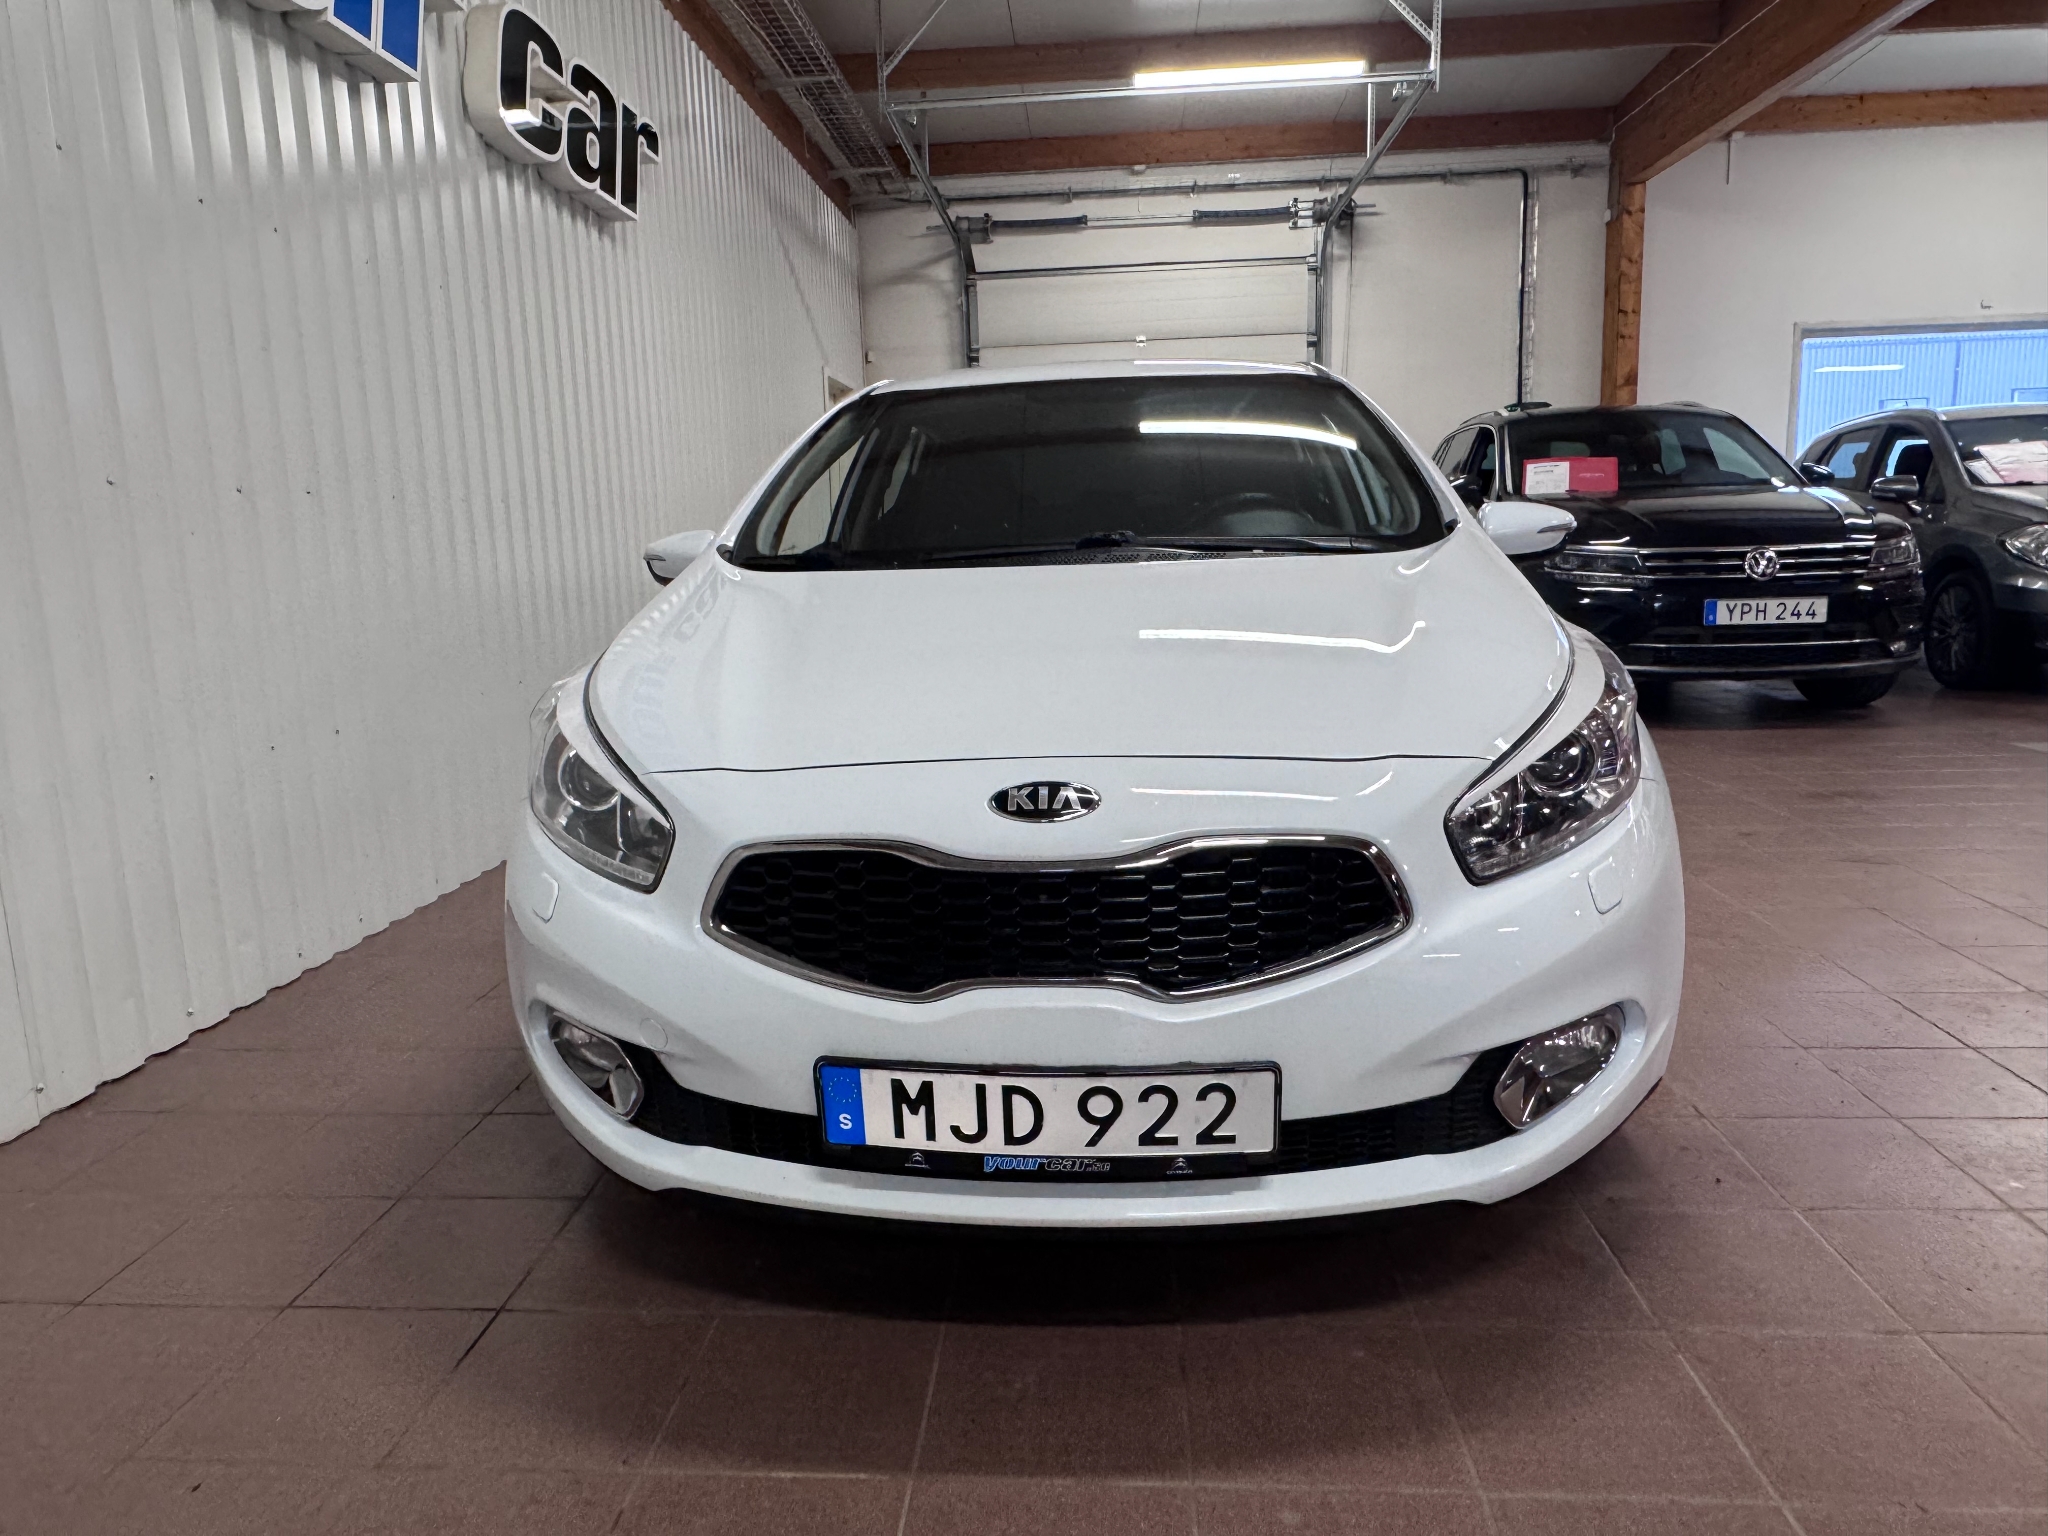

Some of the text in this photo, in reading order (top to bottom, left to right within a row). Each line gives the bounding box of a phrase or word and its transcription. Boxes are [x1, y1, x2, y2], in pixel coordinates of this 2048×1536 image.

[500, 4, 660, 221] Car
[1725, 601, 1817, 622] YPH 244
[1007, 786, 1081, 811] KIA
[838, 1078, 1237, 1147] S MJD 922
